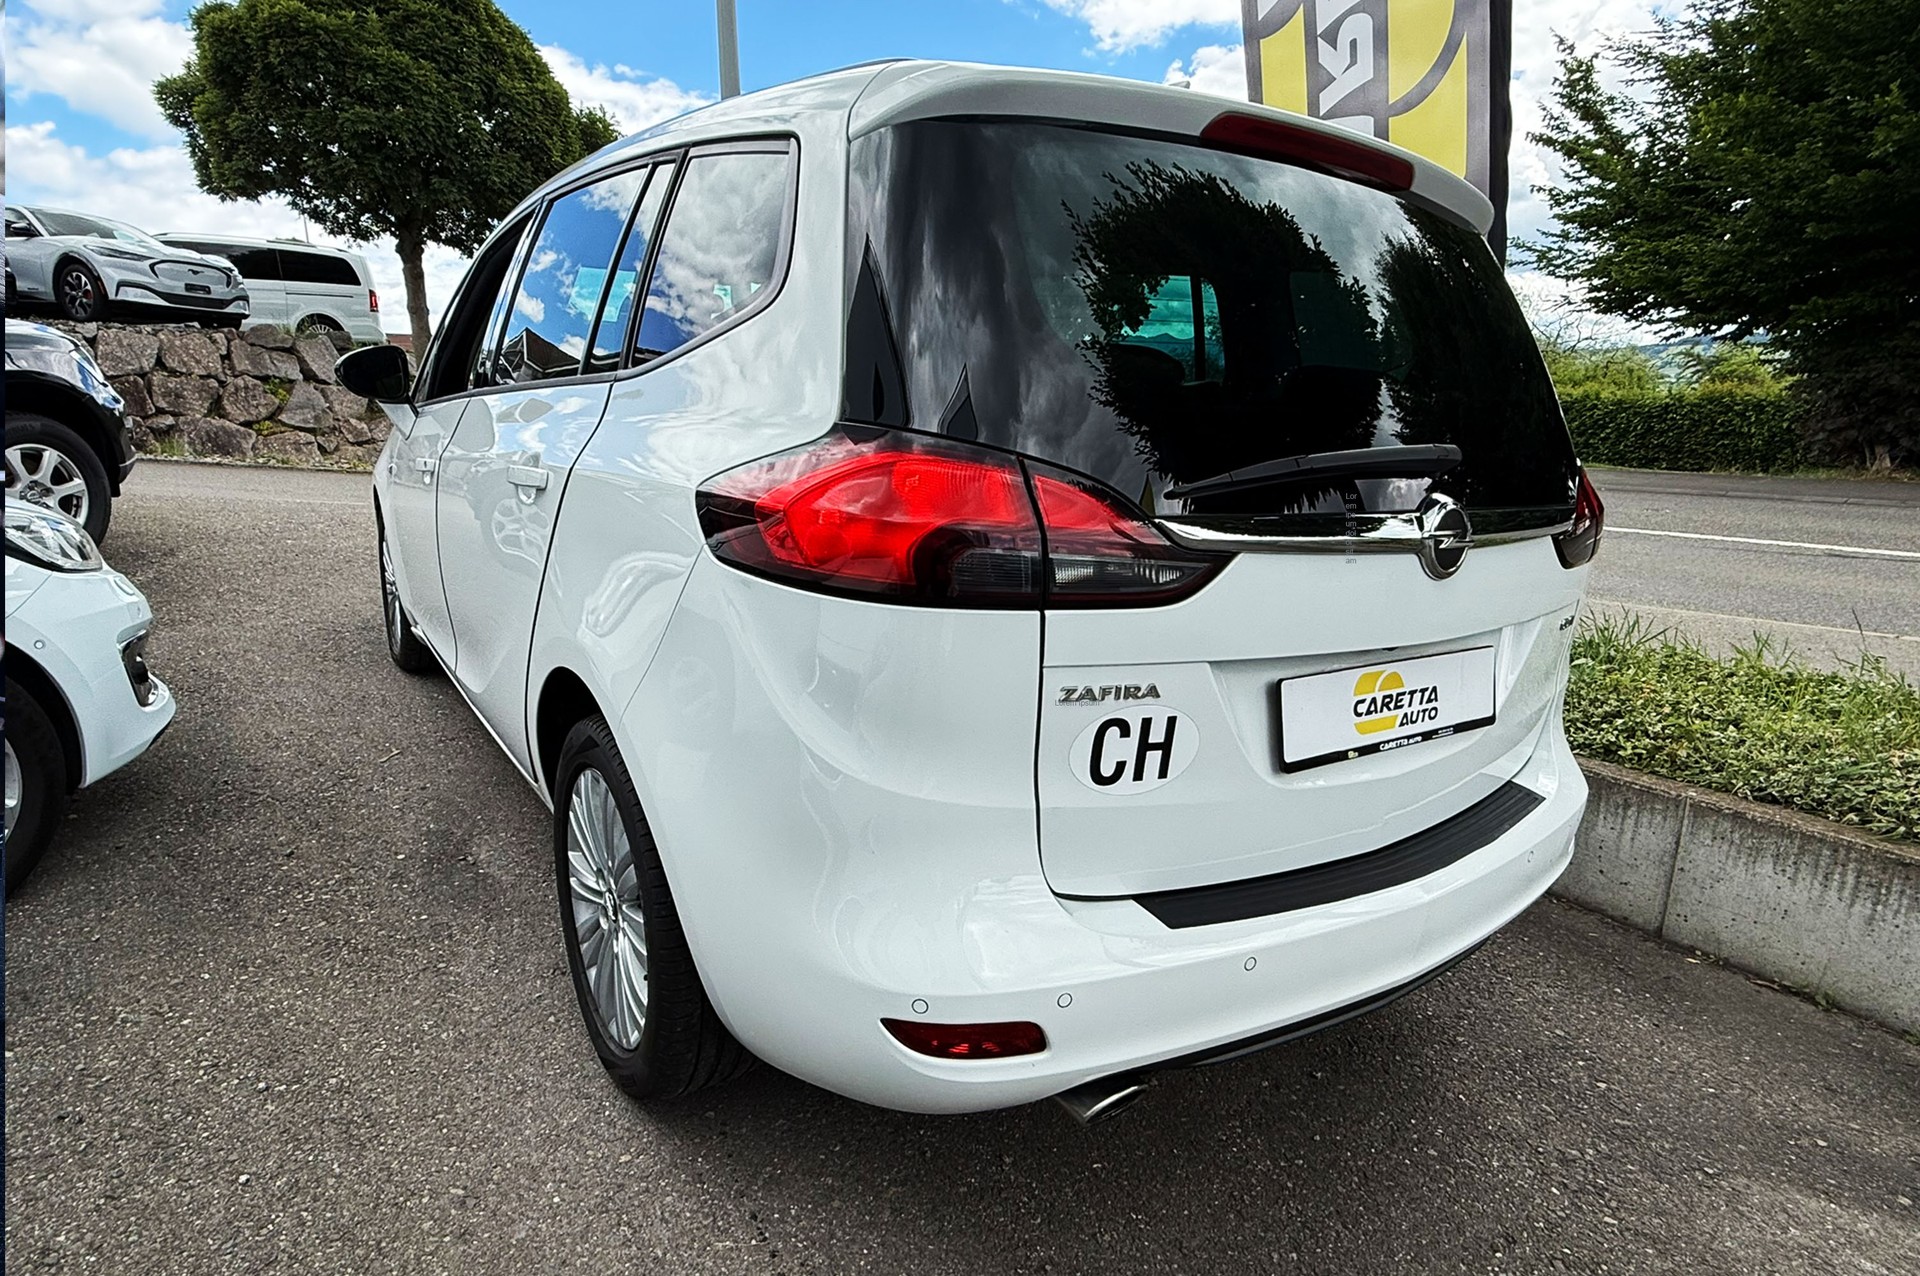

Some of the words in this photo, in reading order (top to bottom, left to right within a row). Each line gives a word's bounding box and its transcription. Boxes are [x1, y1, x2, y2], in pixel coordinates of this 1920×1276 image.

[1058, 683, 1161, 702] ZAFIRA
[1353, 685, 1439, 718] CARETTA
[1398, 706, 1439, 728] AUTO
[1089, 715, 1178, 787] CH
